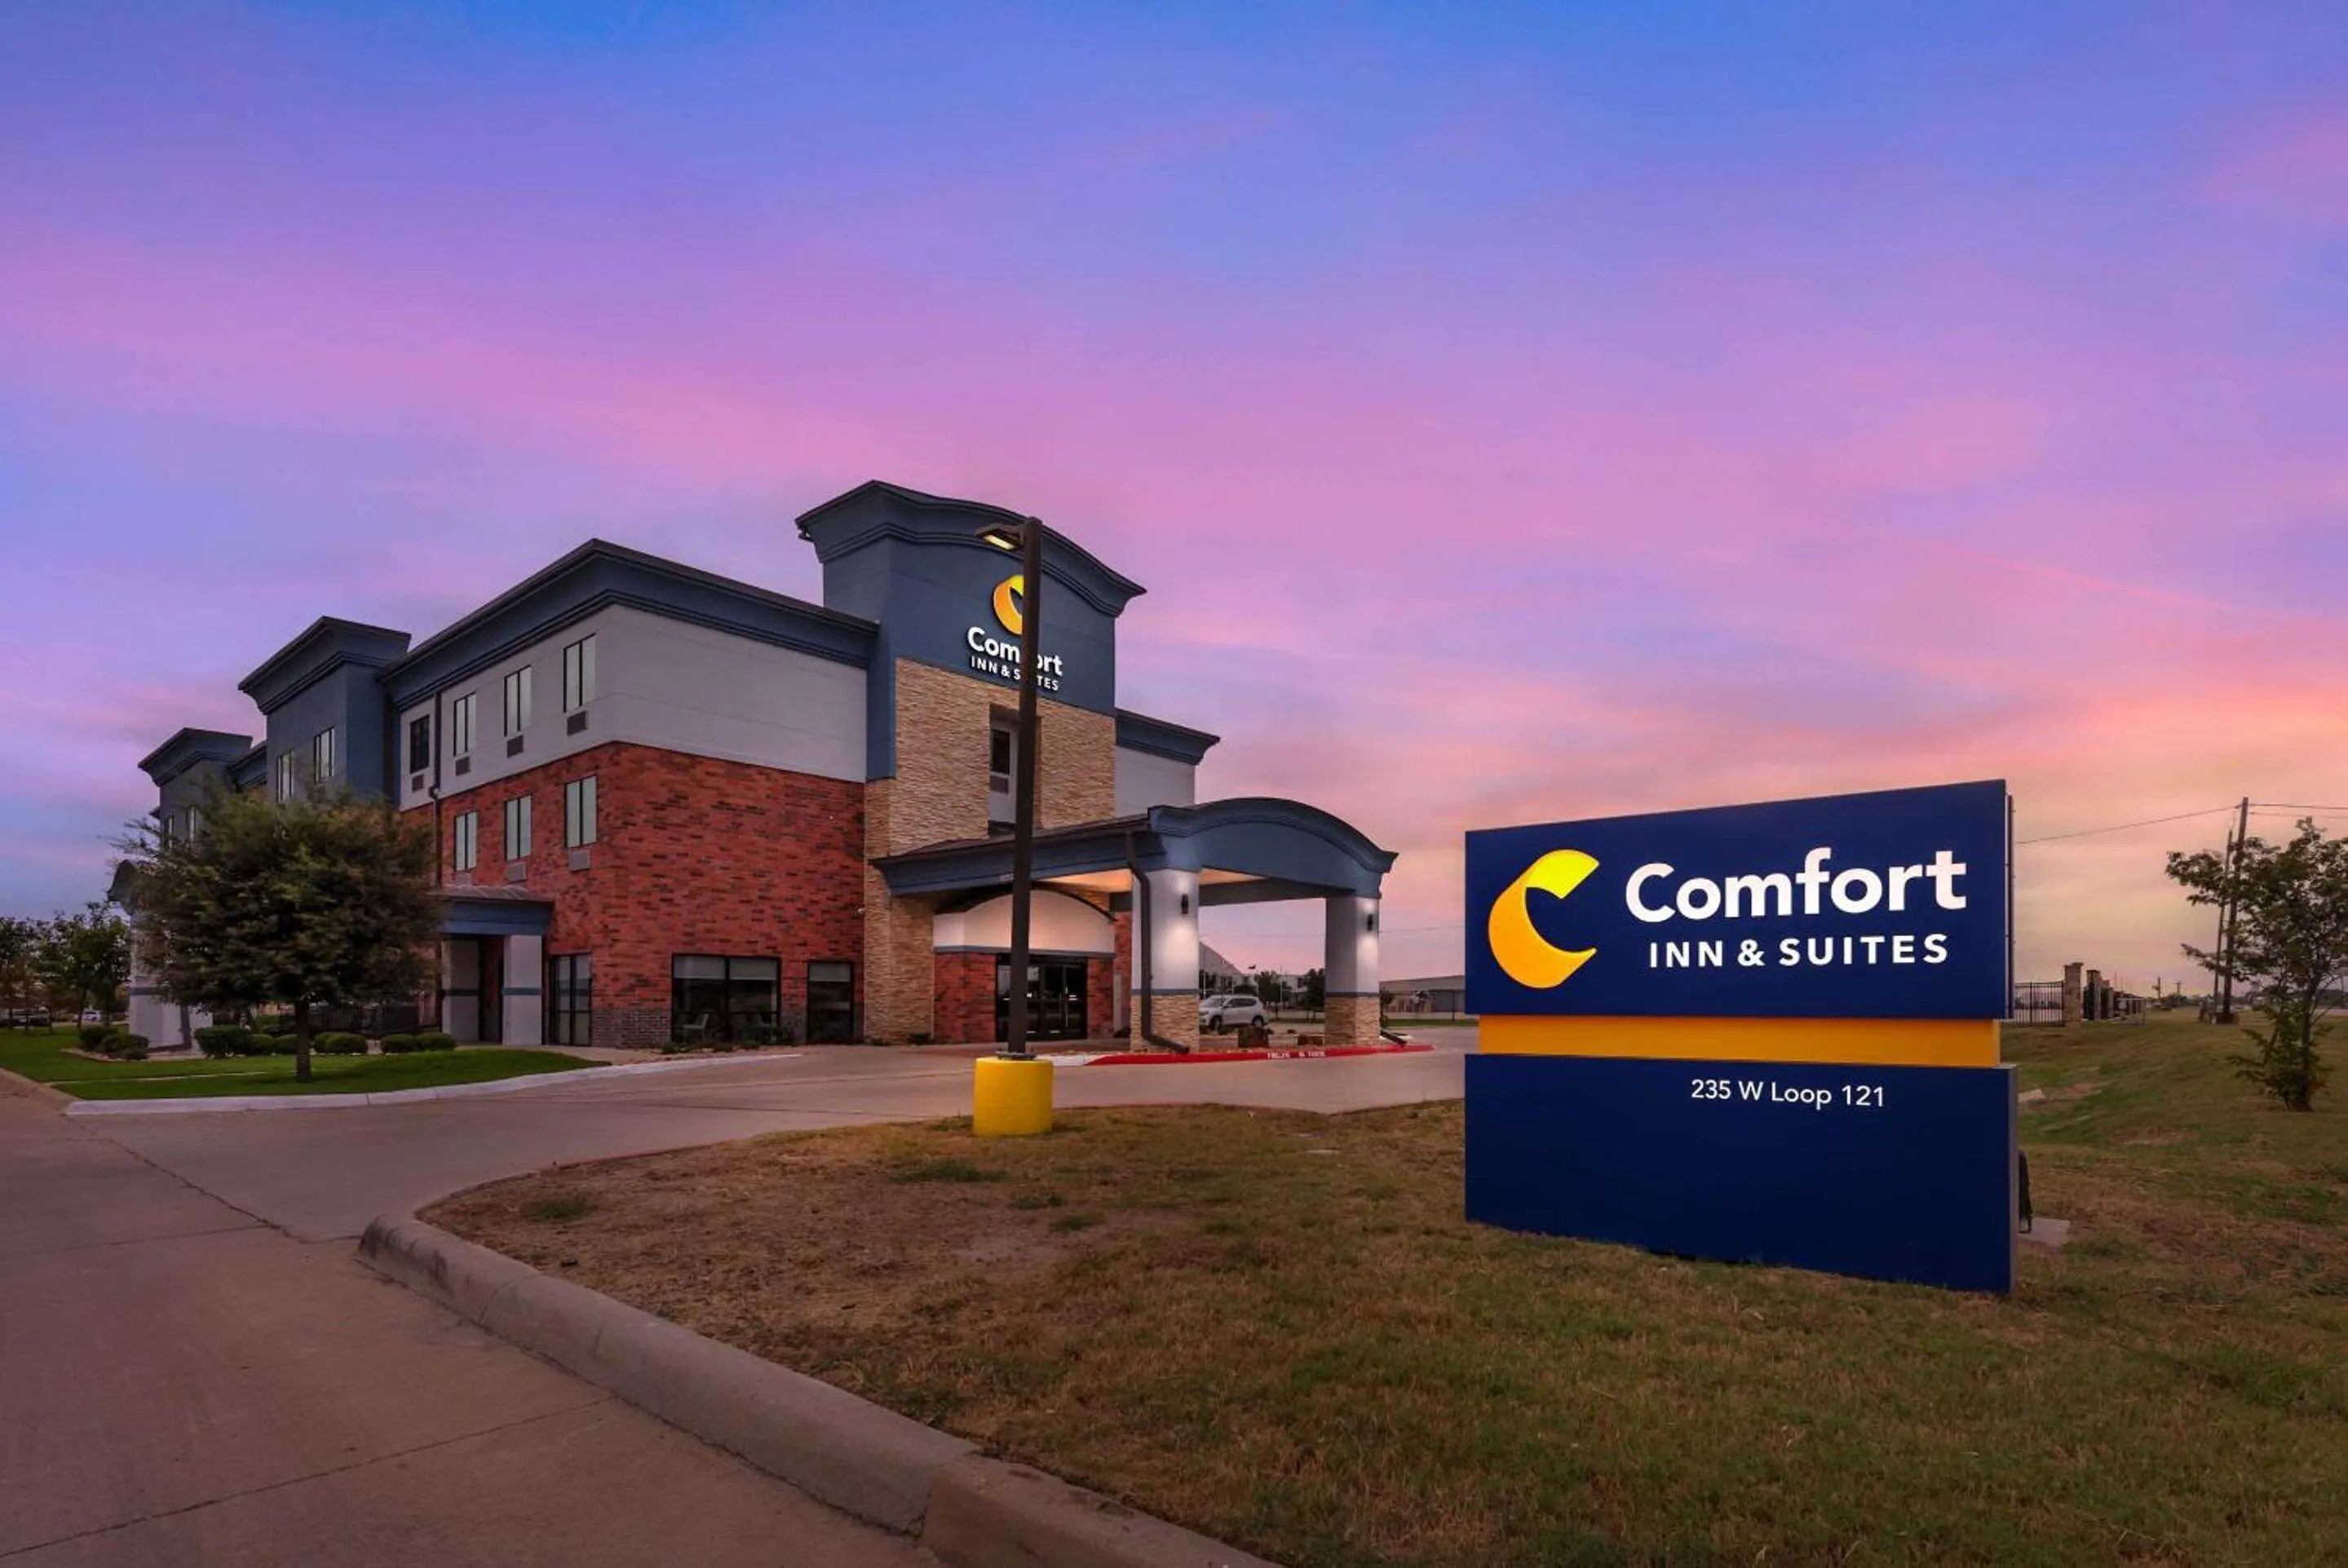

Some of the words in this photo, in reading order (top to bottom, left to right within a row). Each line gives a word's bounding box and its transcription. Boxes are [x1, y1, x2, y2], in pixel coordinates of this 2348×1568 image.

[971, 656, 998, 674] INN
[1001, 665, 1010, 678] &
[1013, 668, 1059, 691] STES
[1625, 846, 1967, 923] Comfort
[1650, 940, 1723, 968] INN
[1737, 939, 1765, 966] &
[1779, 934, 1948, 966] SUITES
[1691, 1079, 1731, 1100] 235
[1738, 1080, 1764, 1101] W
[1771, 1081, 1833, 1111] Loop
[1842, 1084, 1884, 1107] 121
